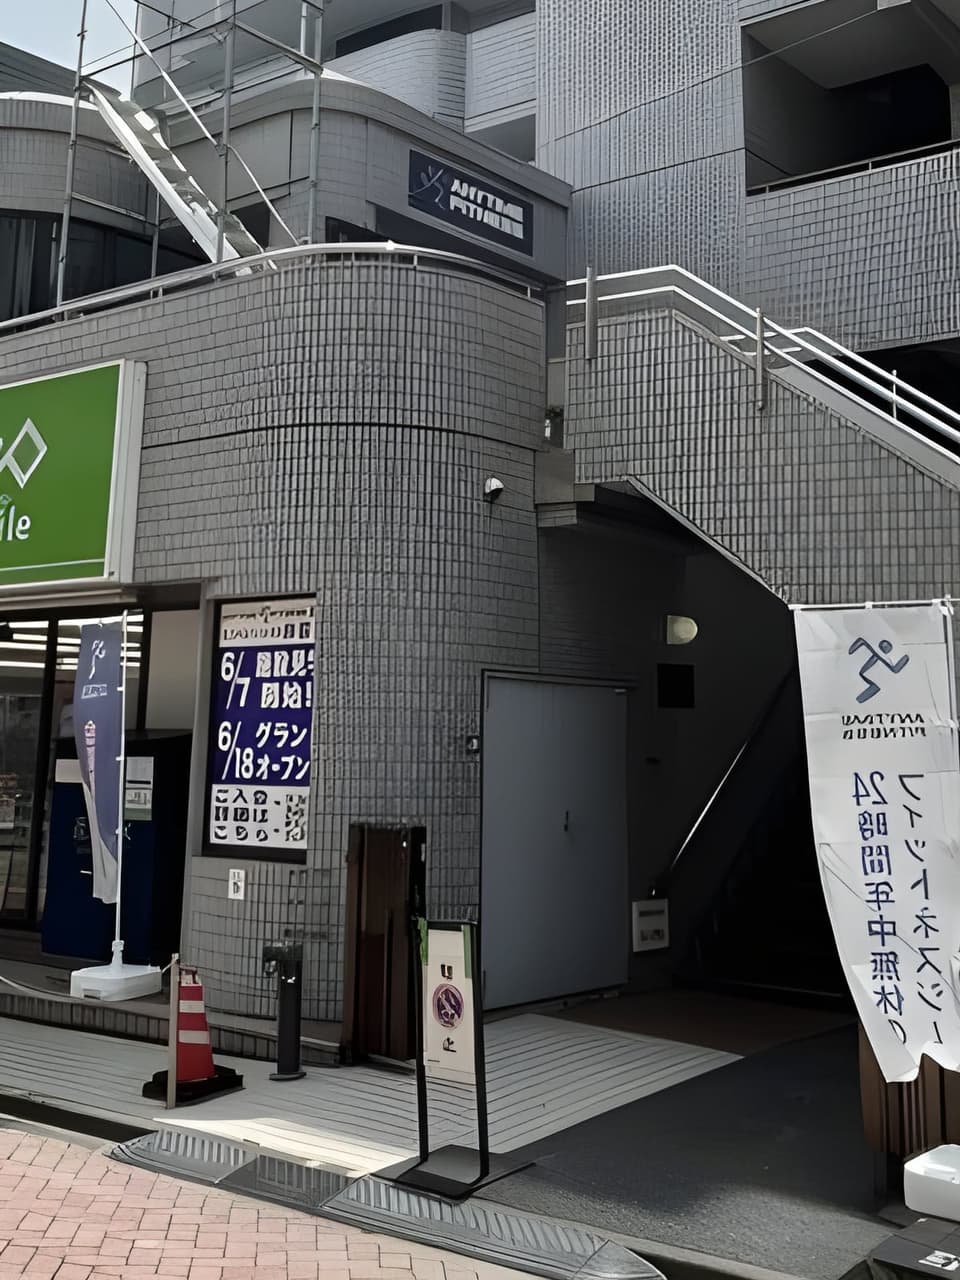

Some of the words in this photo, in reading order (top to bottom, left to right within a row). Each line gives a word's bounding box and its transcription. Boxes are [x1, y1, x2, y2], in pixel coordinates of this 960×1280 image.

[221, 651, 251, 710] 6/7
[217, 721, 254, 780] 6/18
[255, 721, 308, 749] グラン
[255, 753, 311, 780] オープン
